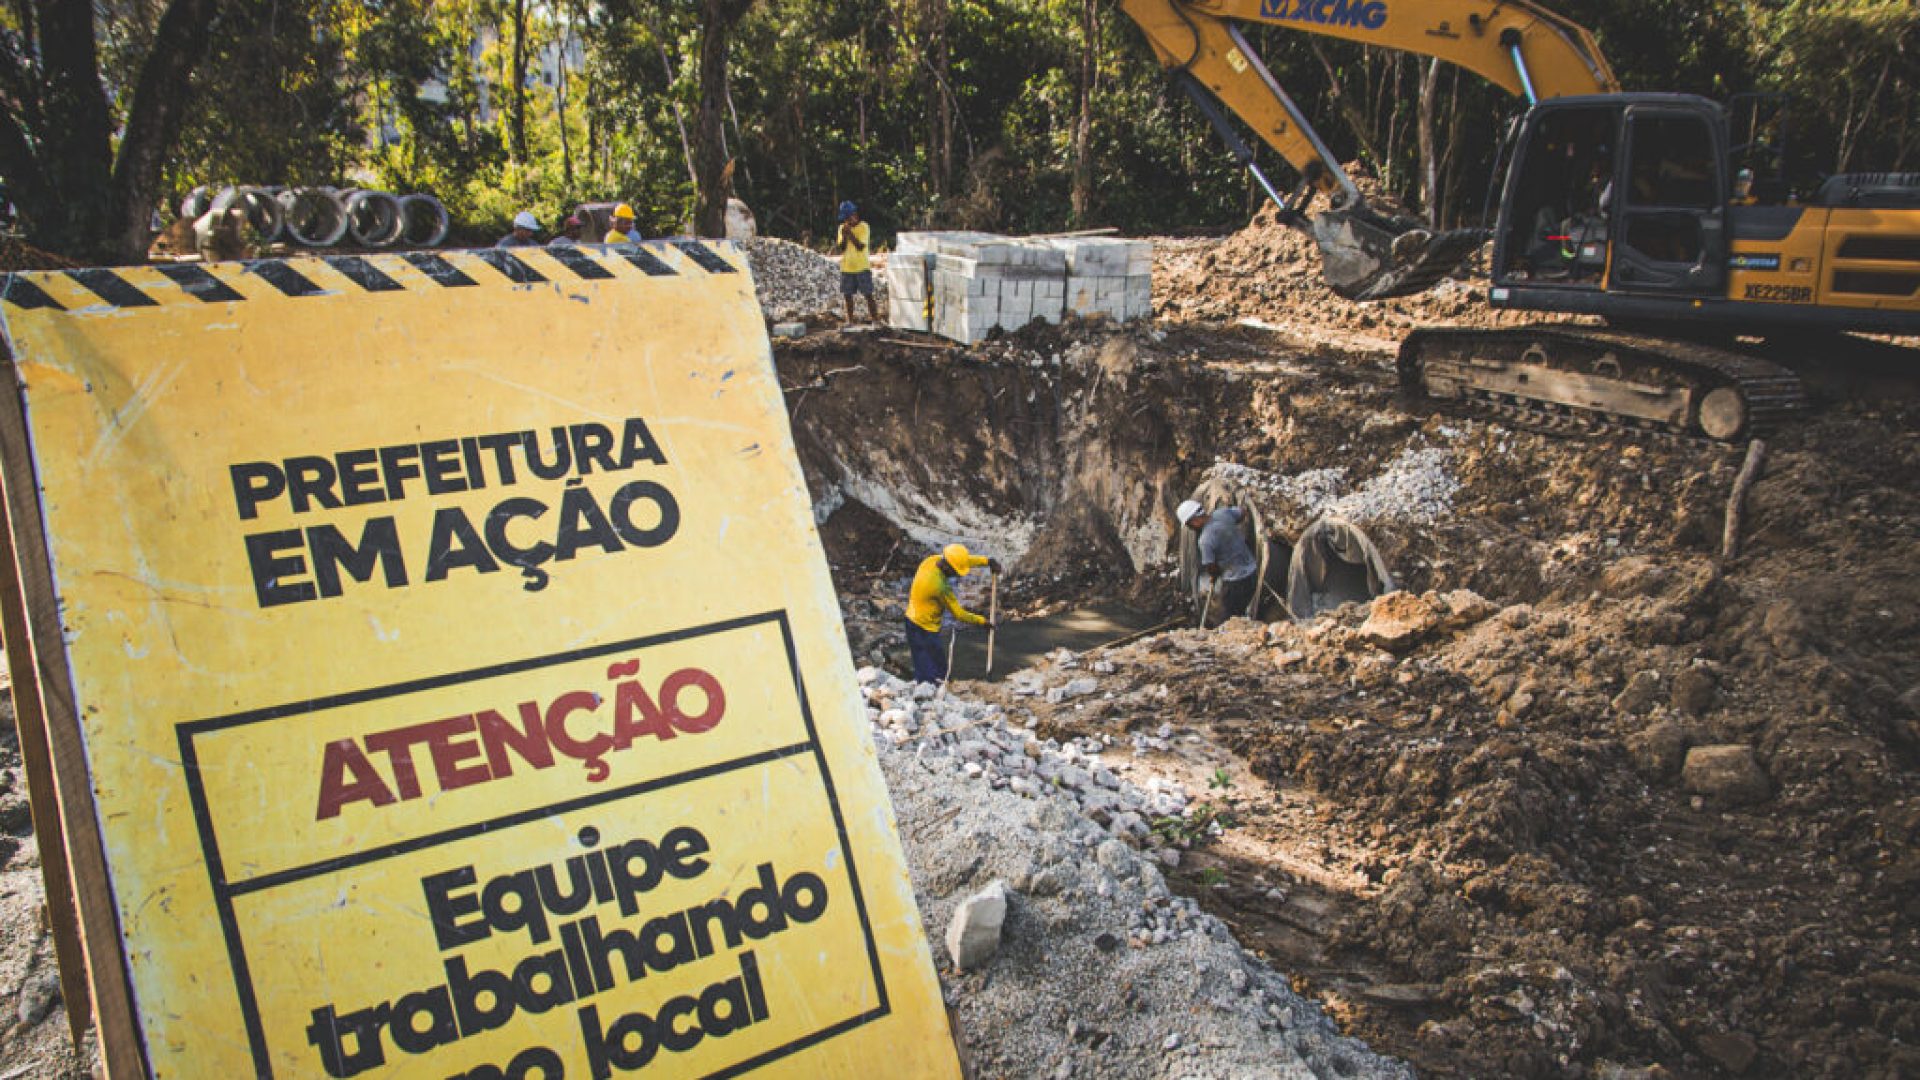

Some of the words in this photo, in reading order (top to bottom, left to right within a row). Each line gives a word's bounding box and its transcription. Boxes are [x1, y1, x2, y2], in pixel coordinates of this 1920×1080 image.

[1287, 0, 1388, 29] XCMG
[230, 418, 667, 519] PREFEITURA
[244, 517, 408, 608] EM
[426, 478, 680, 591] AÇÃO
[316, 658, 726, 820] ATENÇÃO
[421, 826, 709, 951] Equipe
[306, 863, 828, 1080] trabalhando
[445, 1046, 565, 1080] o
[578, 951, 770, 1080] local
